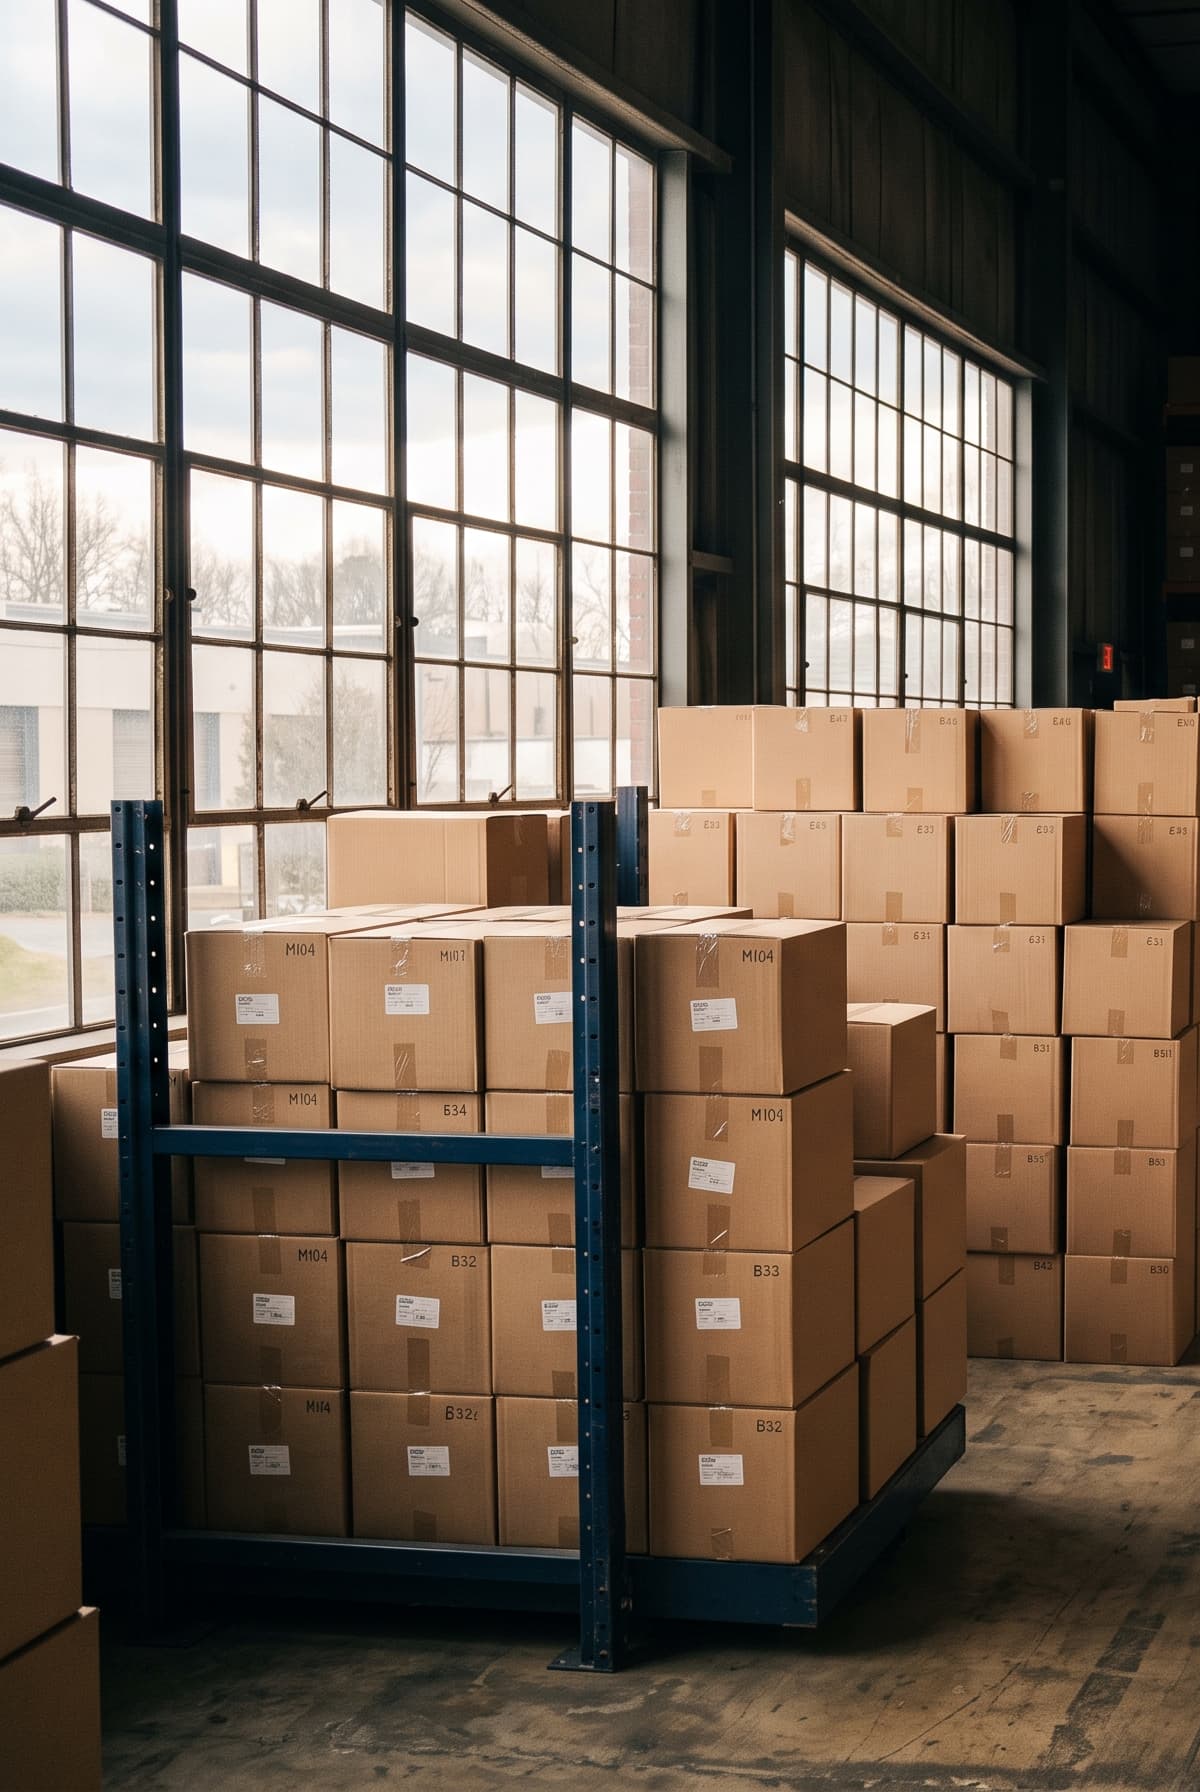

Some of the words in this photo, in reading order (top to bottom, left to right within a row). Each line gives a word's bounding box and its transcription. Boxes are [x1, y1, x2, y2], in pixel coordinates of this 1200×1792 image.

[285, 942, 316, 957] M104
[742, 949, 774, 964] M104
[288, 1092, 318, 1106] M104
[751, 1108, 784, 1122] M104
[298, 1248, 328, 1263] M104
[451, 1255, 477, 1268] B32
[753, 1264, 780, 1278] B33
[756, 1419, 783, 1433] B32
